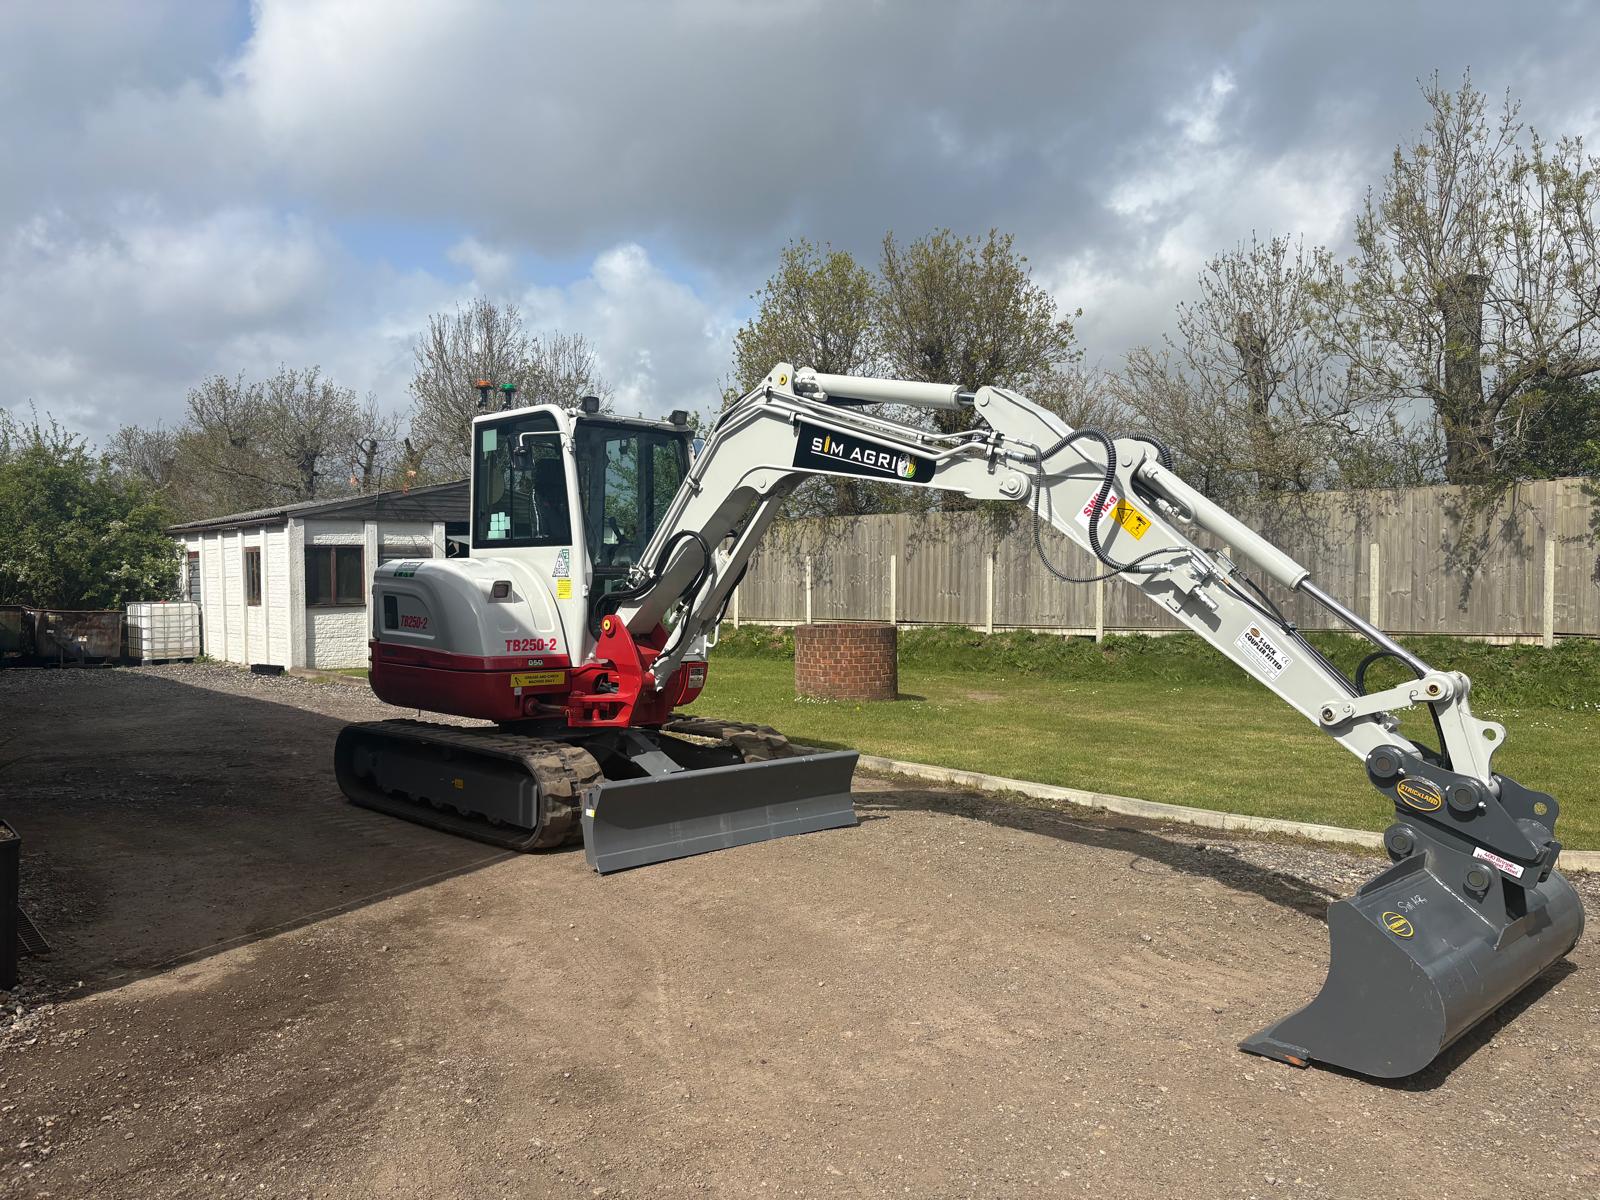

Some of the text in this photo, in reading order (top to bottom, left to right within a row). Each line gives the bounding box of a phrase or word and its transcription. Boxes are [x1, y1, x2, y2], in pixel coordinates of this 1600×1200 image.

[811, 434, 897, 470] SIM AGRI
[505, 638, 557, 652] TB250-2
[1244, 632, 1266, 655] COUPLER
[1265, 653, 1282, 670] FITTED
[1258, 637, 1277, 656] S-LOCK
[1400, 783, 1438, 805] STRICKLAND
